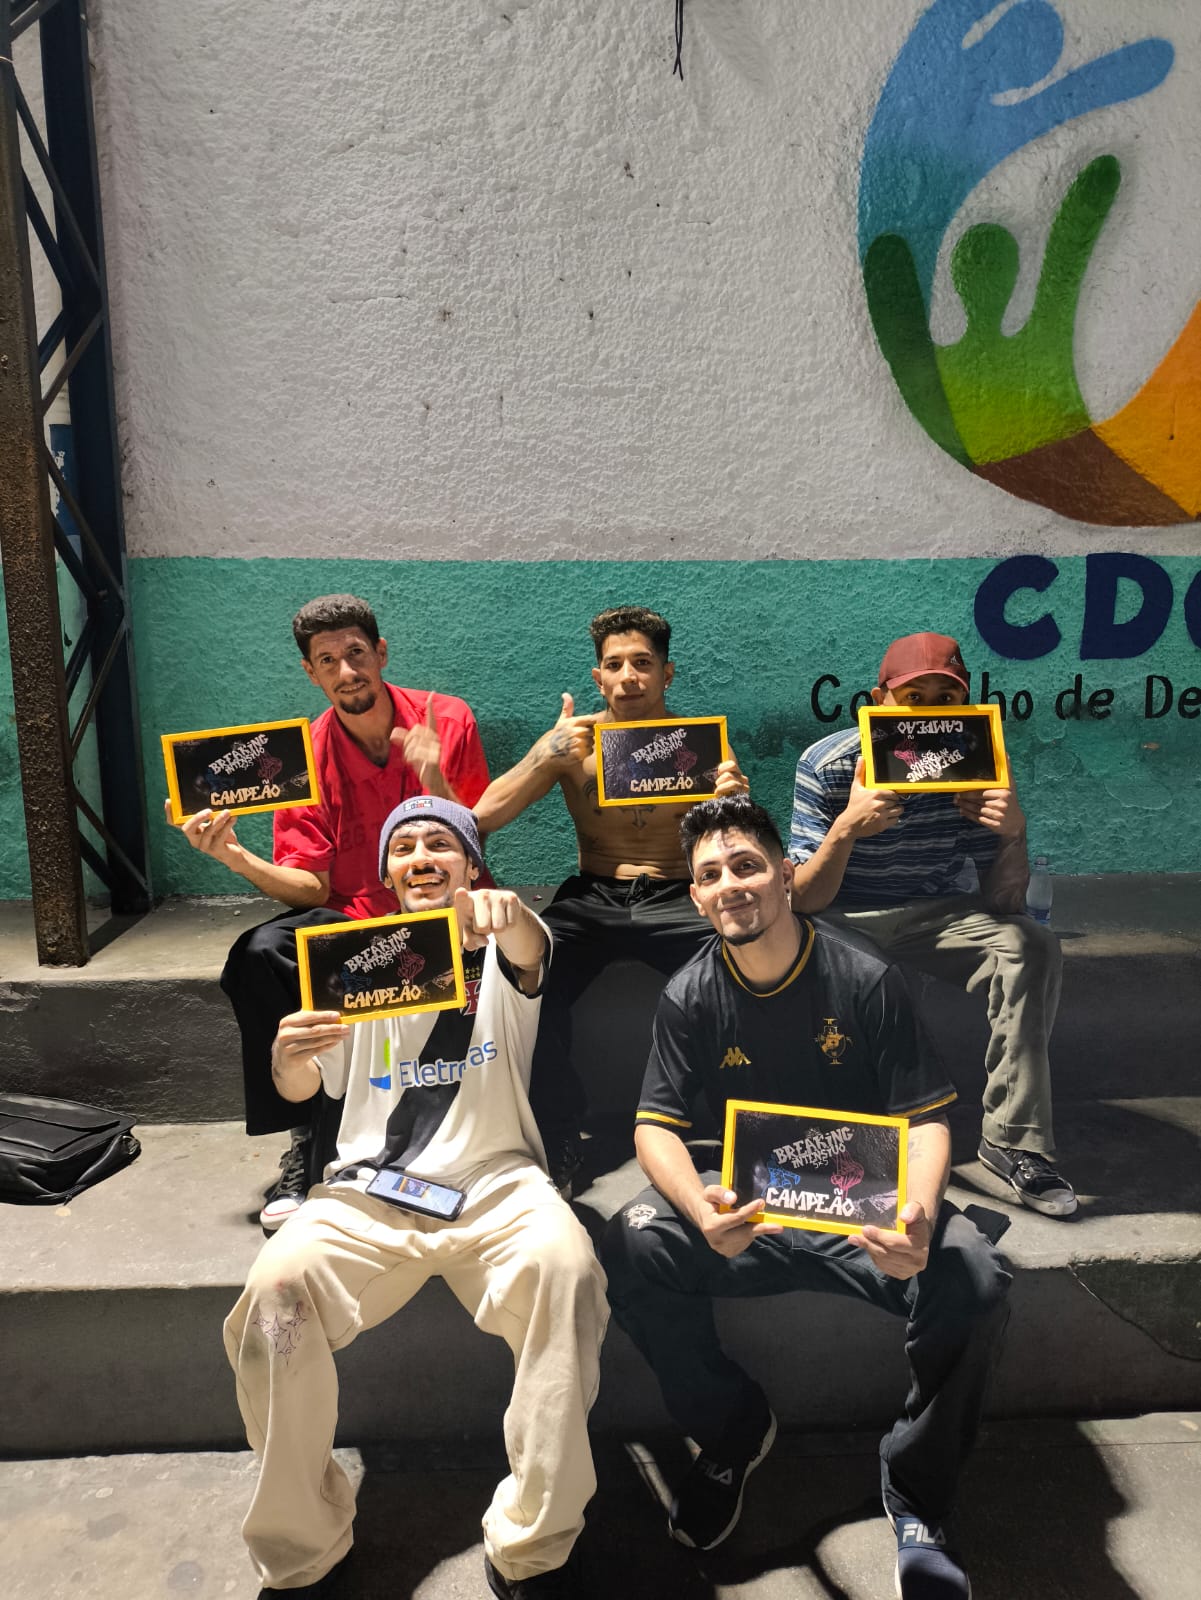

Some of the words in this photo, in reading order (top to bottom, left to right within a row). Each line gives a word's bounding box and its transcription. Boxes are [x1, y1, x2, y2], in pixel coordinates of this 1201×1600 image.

[974, 552, 1201, 660] CD
[1055, 673, 1114, 720] de
[897, 720, 964, 740] CAMPEÃO
[210, 779, 281, 806] CAMPEÃO
[630, 771, 694, 792] CAMPEÃO
[343, 978, 422, 1009] CAMPEÃO
[766, 1187, 854, 1217] CAMPEÃO
[700, 1458, 732, 1485] FILA
[902, 1523, 947, 1545] FILA
